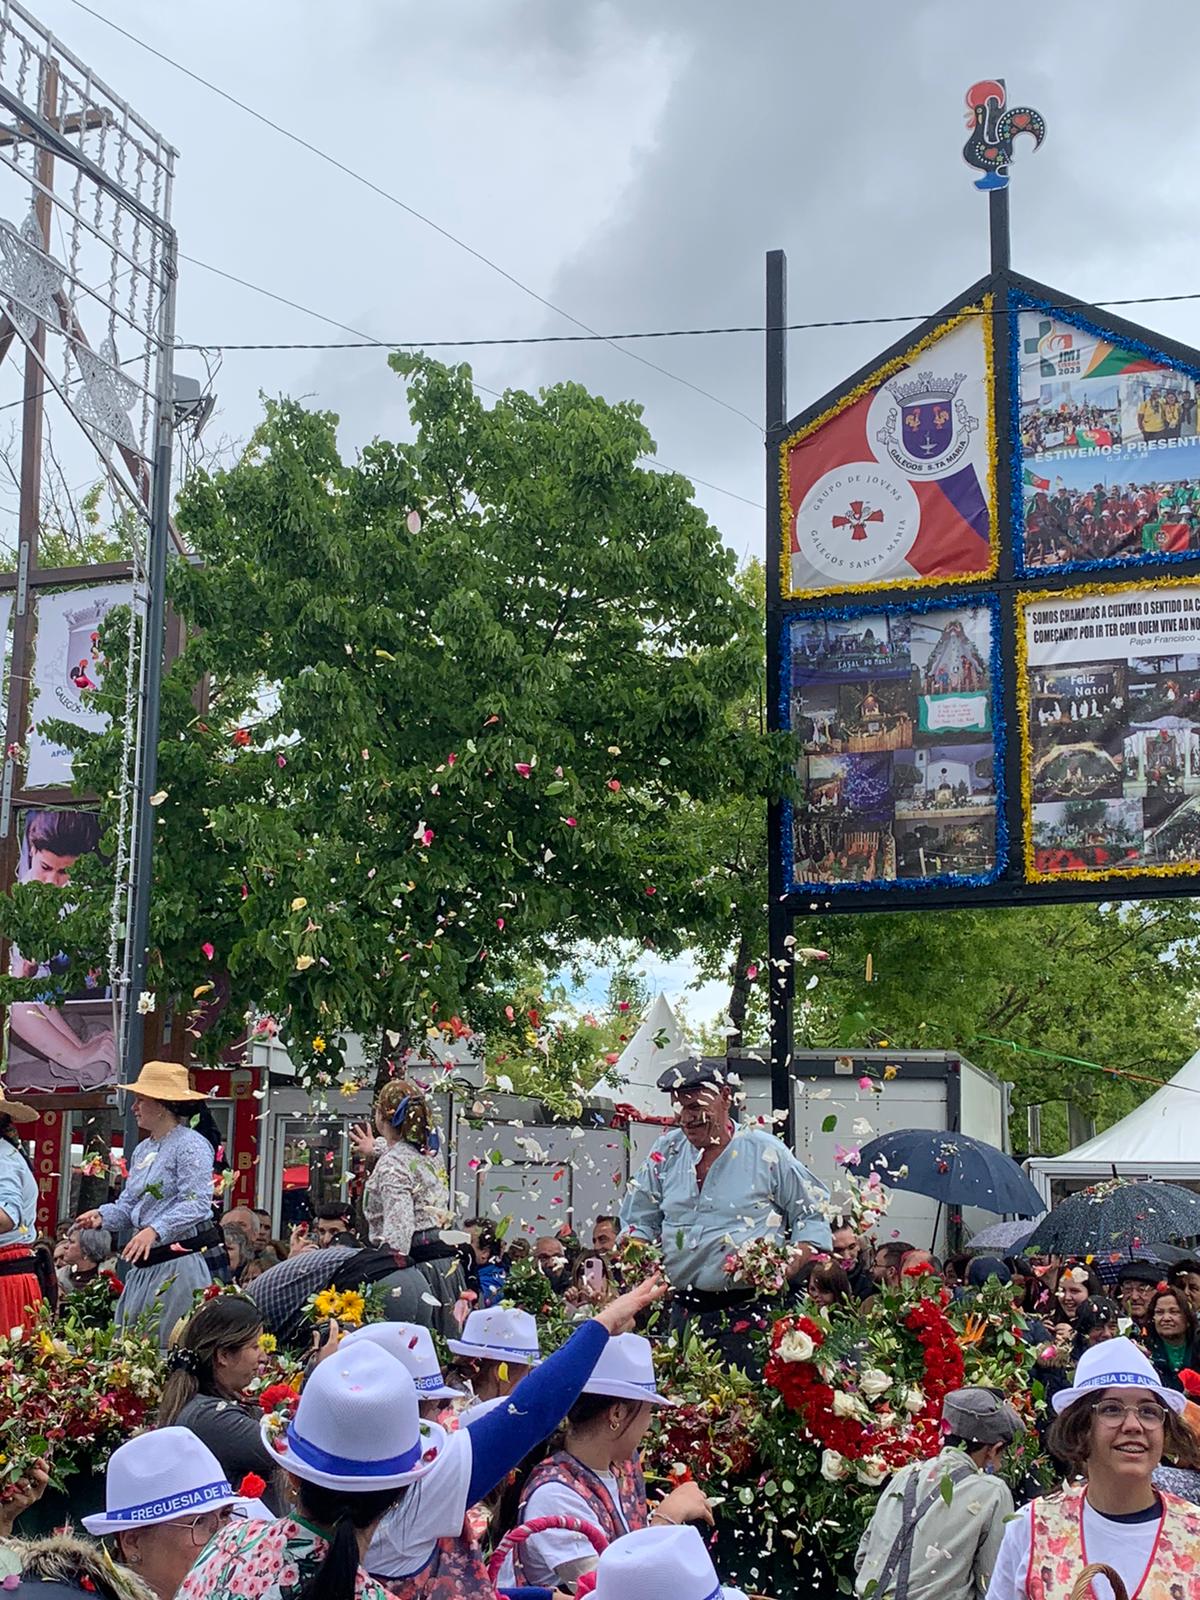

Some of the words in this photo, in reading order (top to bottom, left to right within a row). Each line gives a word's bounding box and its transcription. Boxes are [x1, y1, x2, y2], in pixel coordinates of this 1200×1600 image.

[1058, 366, 1081, 375] 2023
[890, 449, 923, 471] GALEGOS
[947, 441, 966, 463] MARIA
[1035, 443, 1122, 463] ESTIVEMOS
[1127, 435, 1200, 453] PRESENT
[813, 481, 842, 511] GRUPO
[848, 475, 861, 483] DE
[866, 475, 902, 501] JOVENS
[810, 529, 844, 567] GALEGOS
[849, 554, 884, 569] SANTA
[887, 519, 906, 552] MARIA
[1060, 606, 1100, 622] CHAMADOS
[1101, 605, 1107, 618] A
[1108, 602, 1142, 618] CULTIVAR
[1144, 602, 1149, 615] O
[1151, 599, 1182, 614] SENTIDO
[1183, 599, 1193, 611] DA
[1034, 627, 1078, 644] COMEÇANDO
[1080, 625, 1094, 639] POR
[1096, 624, 1103, 638] IR
[1105, 623, 1118, 637] TER
[1120, 621, 1136, 636] COM
[1138, 620, 1159, 636] QUEM
[1161, 618, 1177, 632] VIVE
[1179, 617, 1189, 631] AO
[1130, 637, 1152, 646] Papa
[1154, 634, 1196, 643] Francisco
[1071, 674, 1096, 685] Feliz
[1075, 684, 1109, 697] Natal
[55, 686, 81, 714] GALEGOS
[1120, 1374, 1135, 1383] DE
[131, 1491, 202, 1520] FREGUESIA
[204, 1485, 219, 1500] DE
